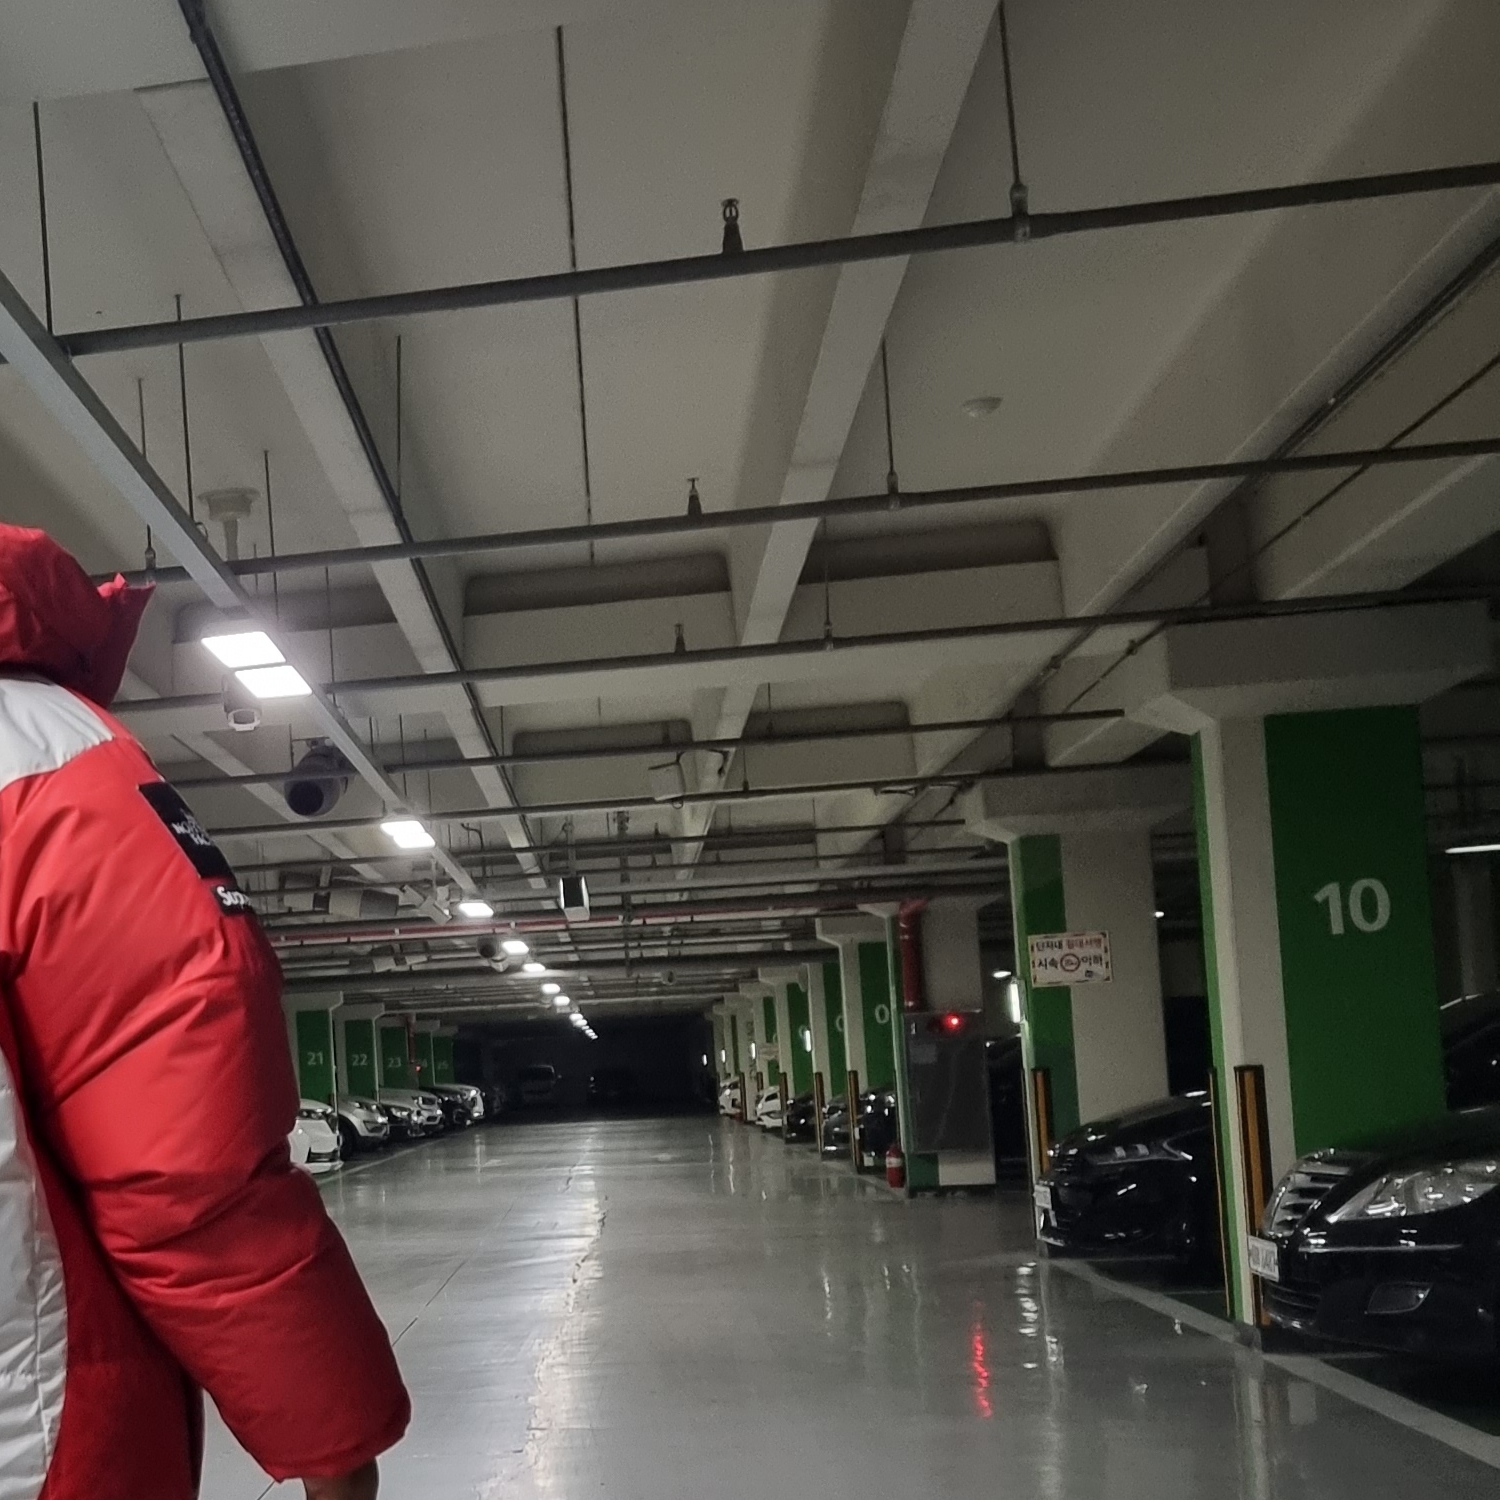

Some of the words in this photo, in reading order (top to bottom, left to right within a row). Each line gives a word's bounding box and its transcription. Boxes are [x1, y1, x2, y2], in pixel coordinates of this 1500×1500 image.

[1314, 878, 1391, 935] 10
[307, 1051, 324, 1066] 21
[352, 1053, 368, 1067] 22
[388, 1057, 402, 1068] 23
